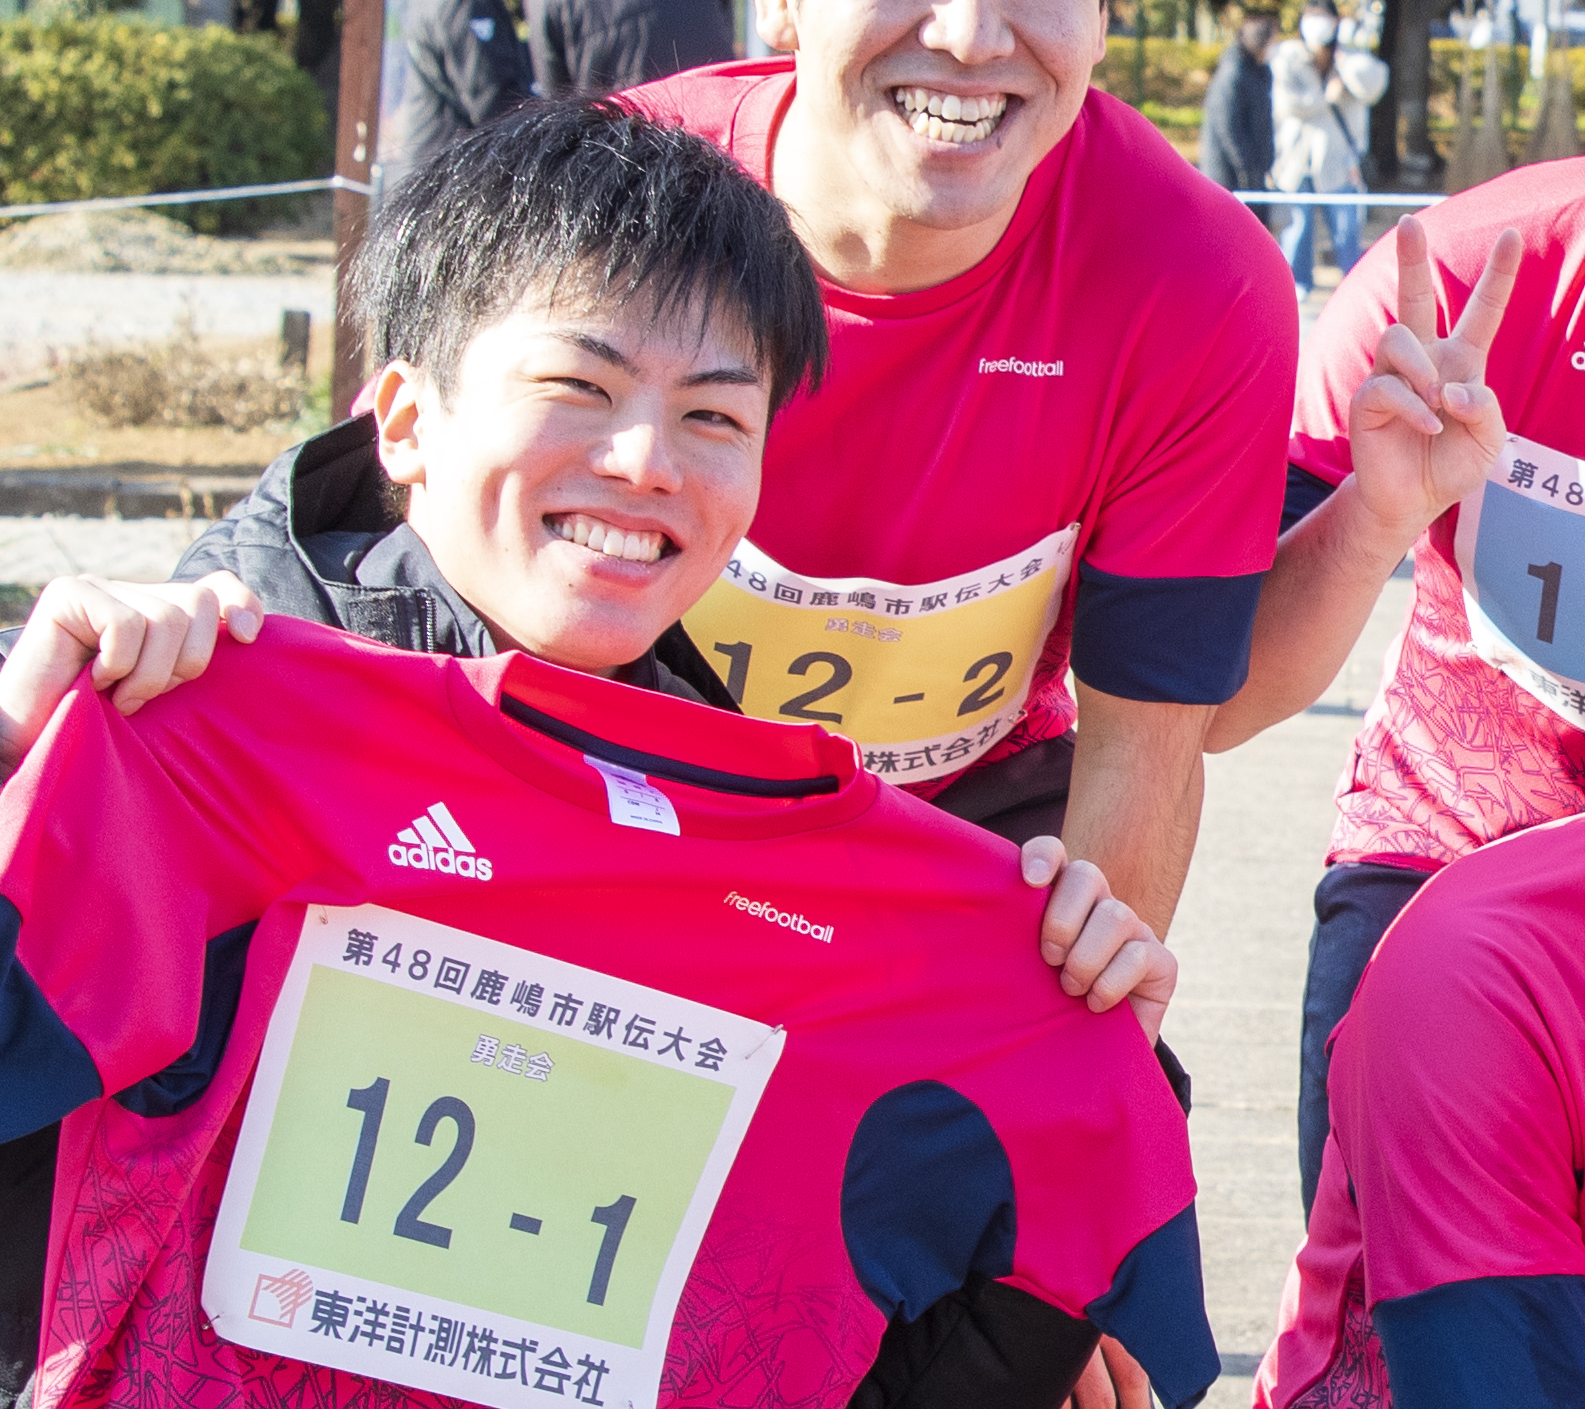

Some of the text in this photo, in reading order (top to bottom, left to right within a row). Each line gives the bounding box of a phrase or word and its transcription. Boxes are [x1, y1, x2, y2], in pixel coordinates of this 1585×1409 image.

[978, 356, 1065, 377] freefootball
[388, 838, 493, 882] adidas
[723, 890, 835, 944] freefootball
[342, 928, 729, 1073] 第48回鹿嶋市駅伝大会
[470, 1033, 556, 1083] 勇走会
[308, 1289, 611, 1409] 東洋計測株式会社
